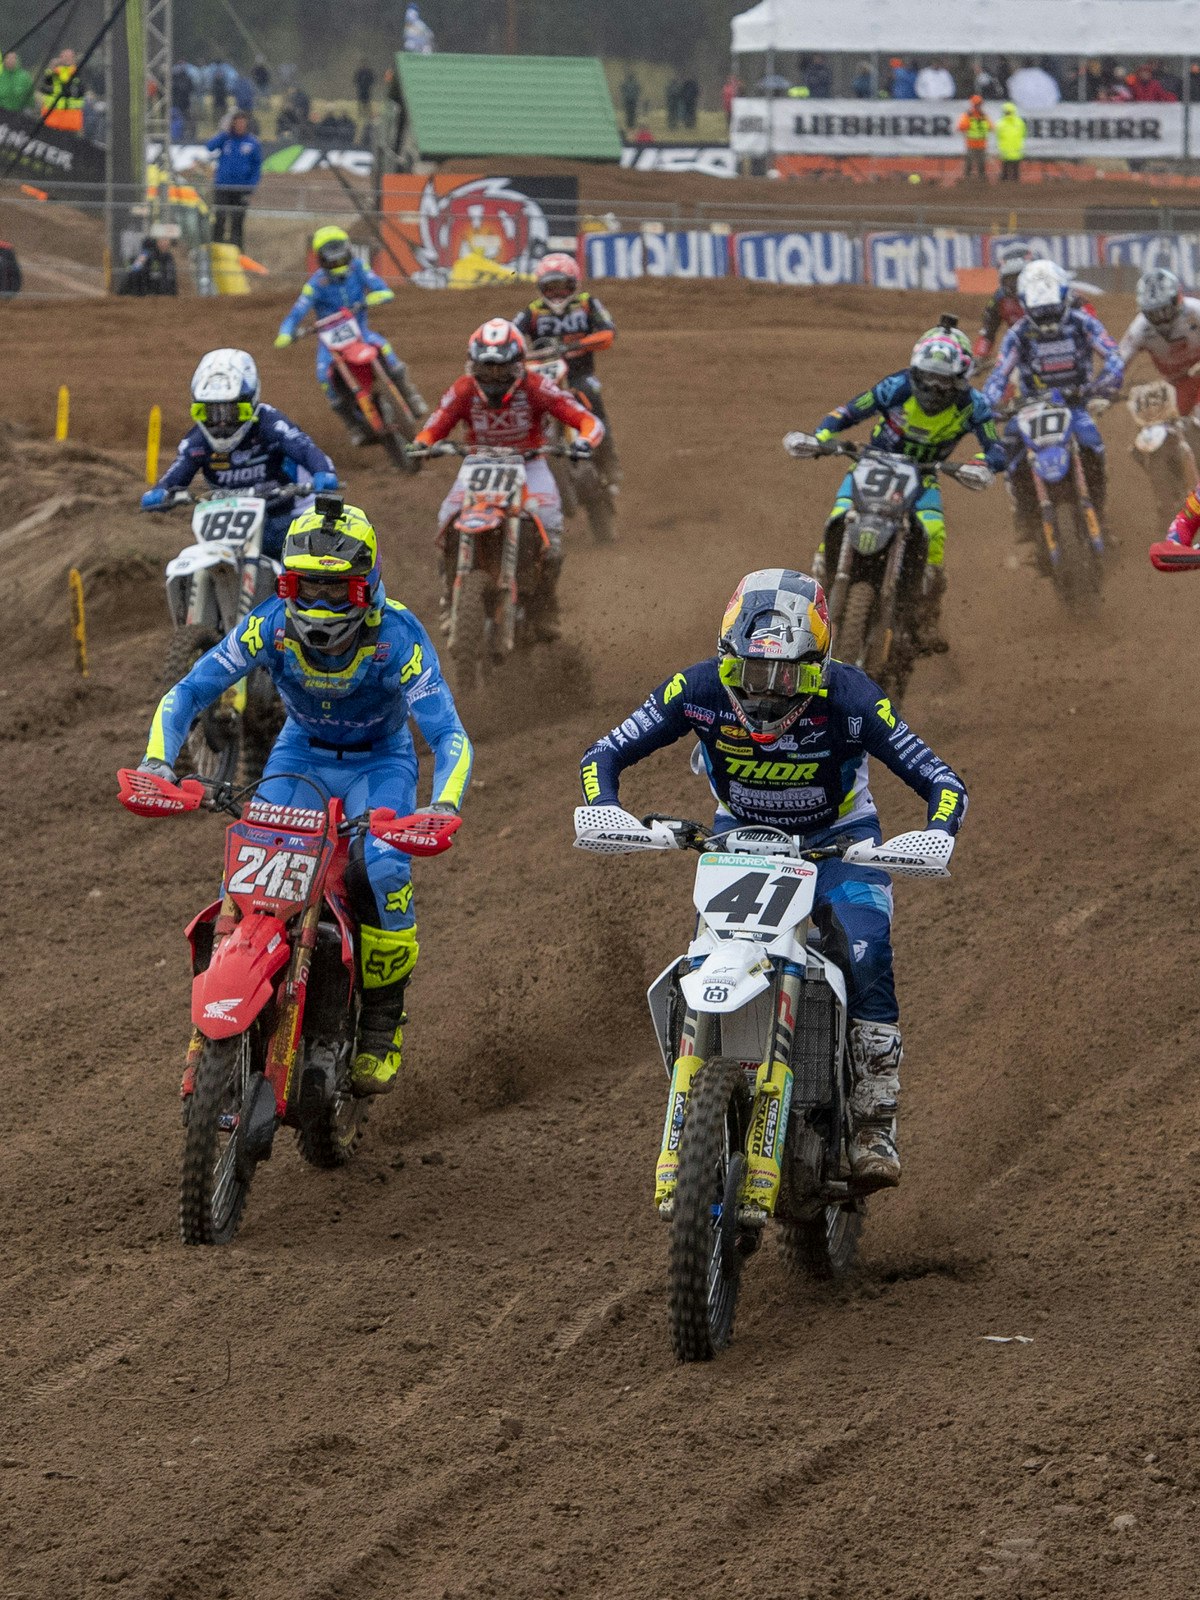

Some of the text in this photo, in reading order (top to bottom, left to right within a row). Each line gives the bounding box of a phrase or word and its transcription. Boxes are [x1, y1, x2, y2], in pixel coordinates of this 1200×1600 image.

[793, 115, 952, 136] LIEBHERR
[1030, 118, 1161, 140] EBHERR
[536, 311, 589, 336] FXR
[1029, 415, 1067, 440] 10
[216, 463, 267, 483] THOR
[468, 467, 519, 493] 911
[200, 511, 256, 542] 189
[212, 652, 237, 674] SHOWA
[720, 709, 737, 722] LATV
[898, 742, 919, 761] BRISK
[724, 757, 819, 781] THOR
[729, 781, 813, 801] STANDING
[128, 795, 185, 810] ACERBIS
[731, 794, 825, 810] CONSTRUCT
[931, 788, 959, 822] THOR
[381, 831, 438, 846] ACERBIS
[597, 832, 652, 843] ACERBIS
[717, 855, 770, 867] MOTOREX
[870, 854, 926, 866] ACERBIS
[228, 845, 318, 902] 243
[781, 866, 815, 877] MXGP
[704, 871, 803, 928] 41
[202, 1012, 238, 1023] HONDA
[763, 1099, 779, 1158] ACERBIS
